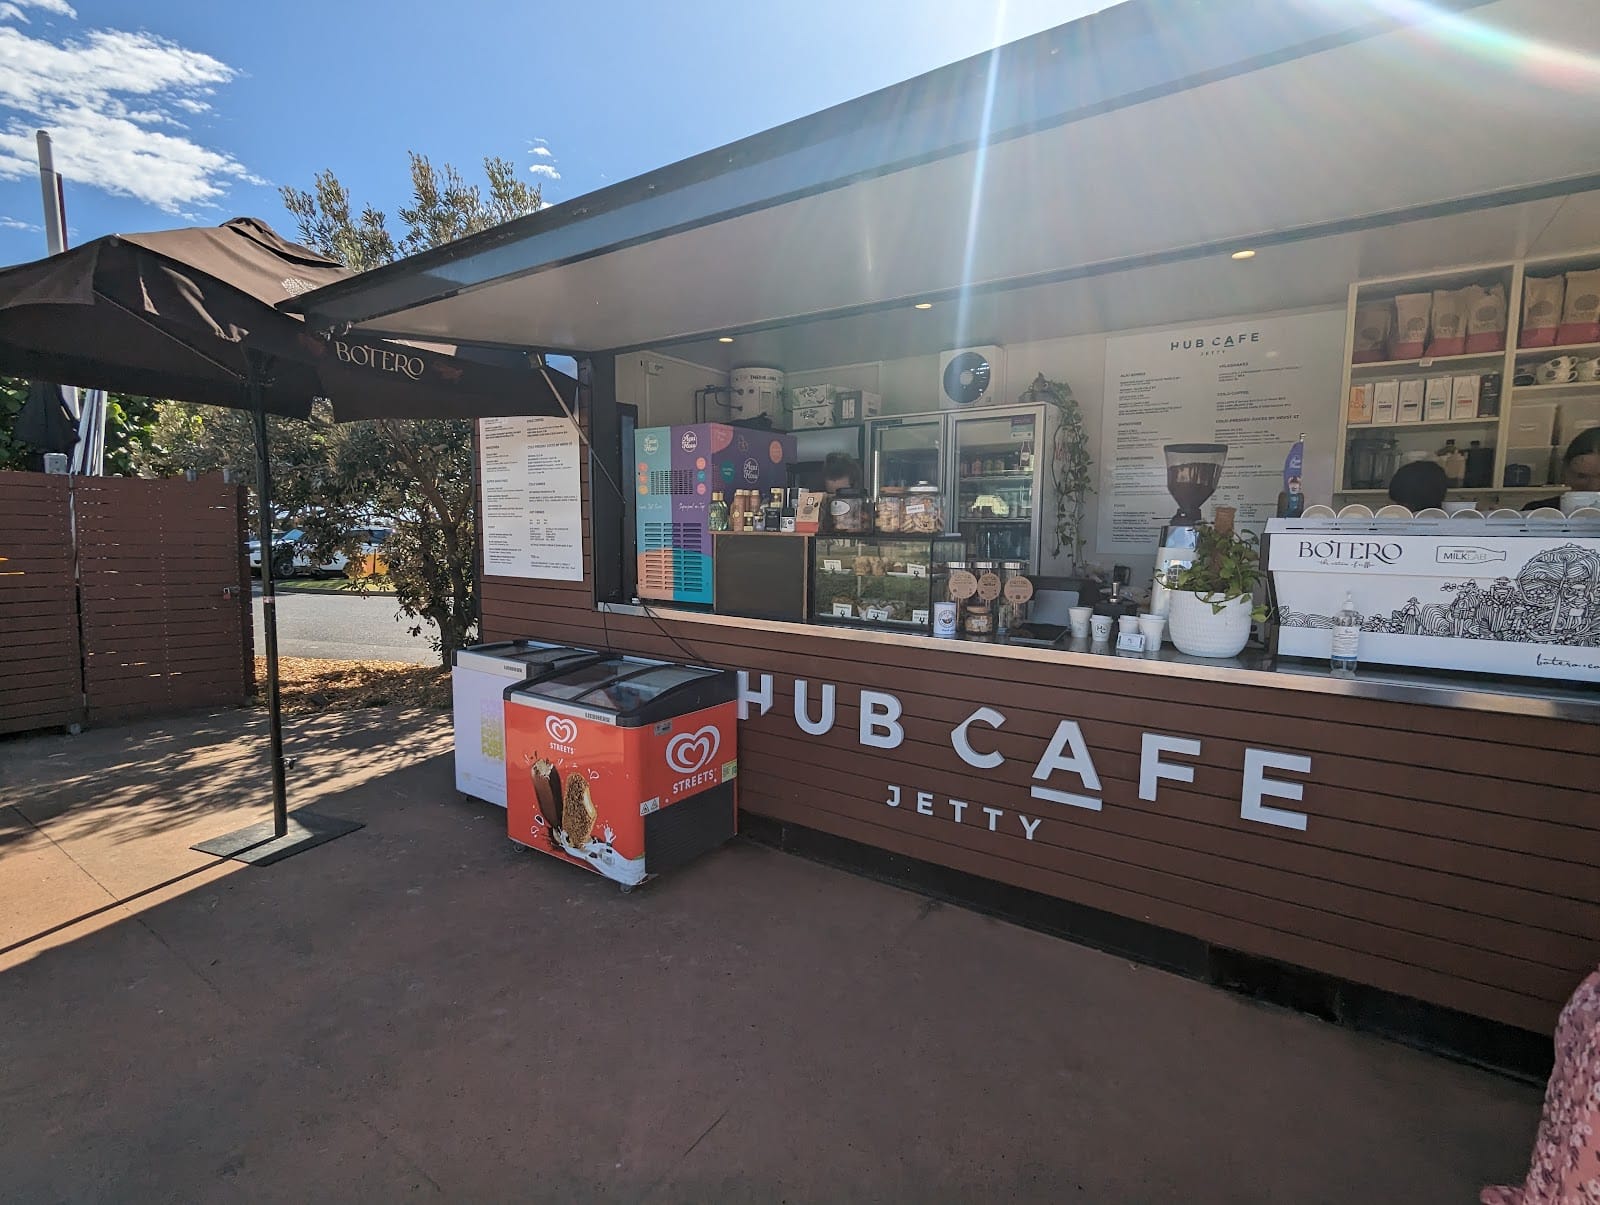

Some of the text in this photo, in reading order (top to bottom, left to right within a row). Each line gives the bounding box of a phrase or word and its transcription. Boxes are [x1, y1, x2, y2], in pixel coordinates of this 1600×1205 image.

[1170, 332, 1260, 351] HUB CAFE
[335, 341, 425, 380] BOTERO
[1299, 540, 1403, 564] BOTERO
[549, 742, 575, 755] STREETS
[737, 670, 1312, 832] HUB CAFE
[672, 769, 714, 794] STREETS
[886, 784, 1043, 841] JETTY
